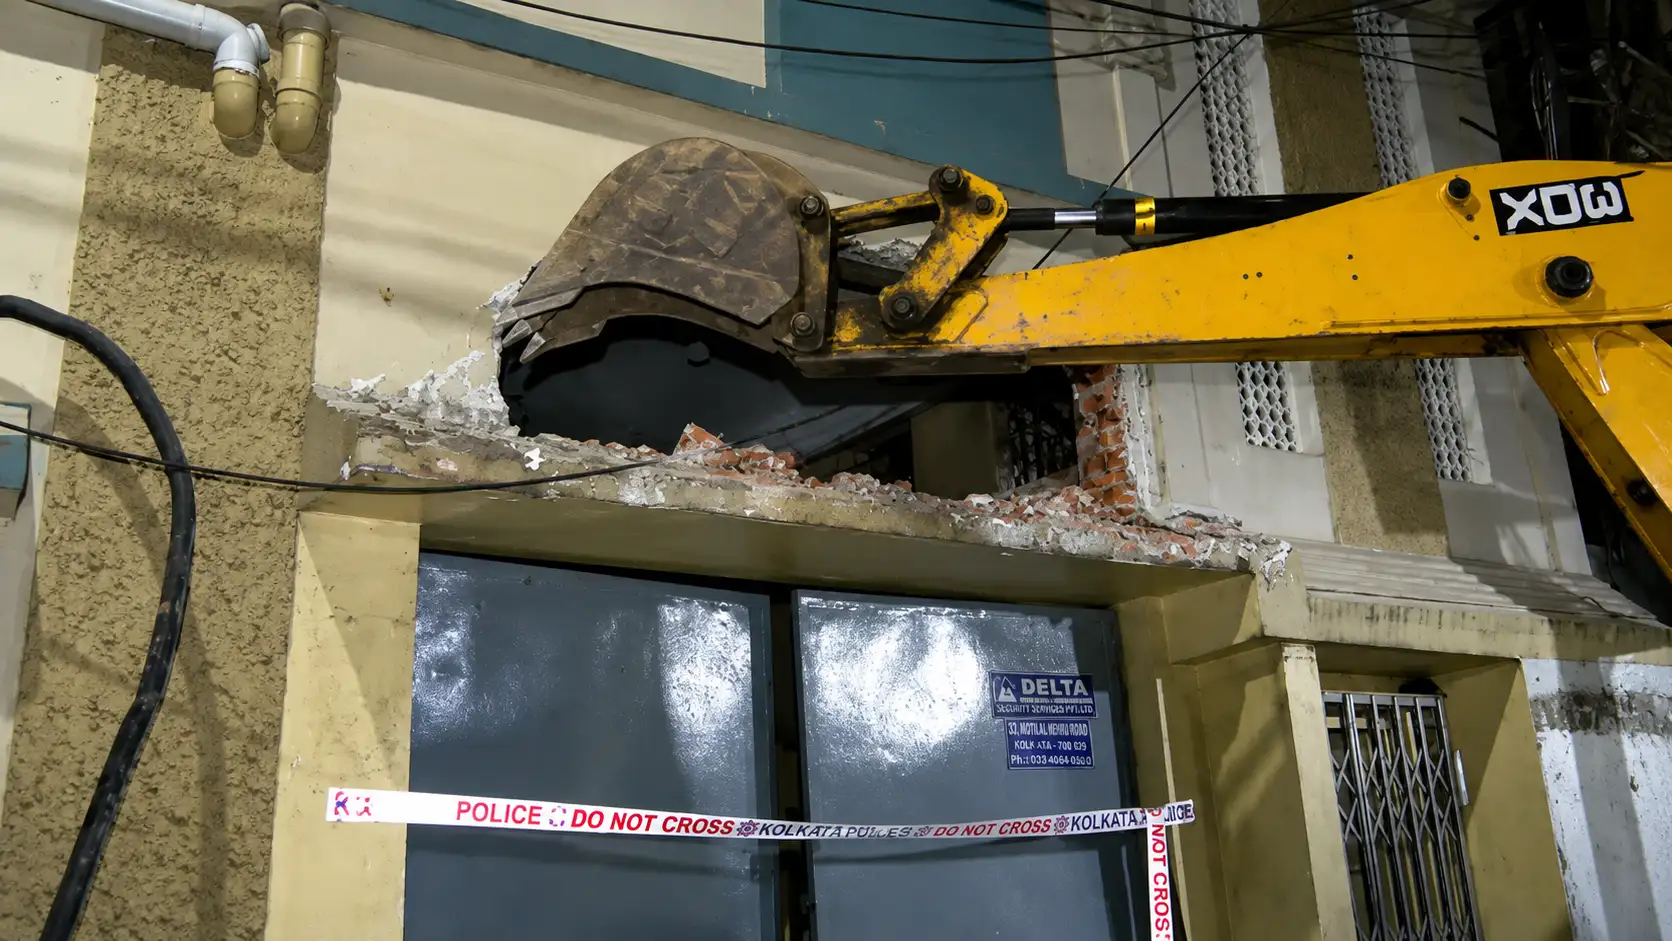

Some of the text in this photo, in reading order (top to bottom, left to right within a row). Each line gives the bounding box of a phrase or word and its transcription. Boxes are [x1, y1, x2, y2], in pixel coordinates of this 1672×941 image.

[1020, 678, 1089, 696] DELTA
[996, 704, 1030, 713] SECURITY
[1031, 704, 1065, 714] SERVICES
[1069, 723, 1088, 736] ROAD
[1058, 741, 1072, 751] 700
[1030, 754, 1047, 765] 033
[1048, 755, 1069, 765] 4064
[456, 801, 543, 825] POLICE
[571, 809, 605, 829] DO
[609, 812, 658, 832] NOT
[661, 815, 735, 835] CROSS
[758, 823, 843, 838] KOLKATA
[933, 826, 960, 836] DO
[961, 823, 997, 836] NOT
[998, 818, 1052, 835] CROSS
[1071, 810, 1137, 832] KOLKATA
[1152, 824, 1167, 867] NOT
